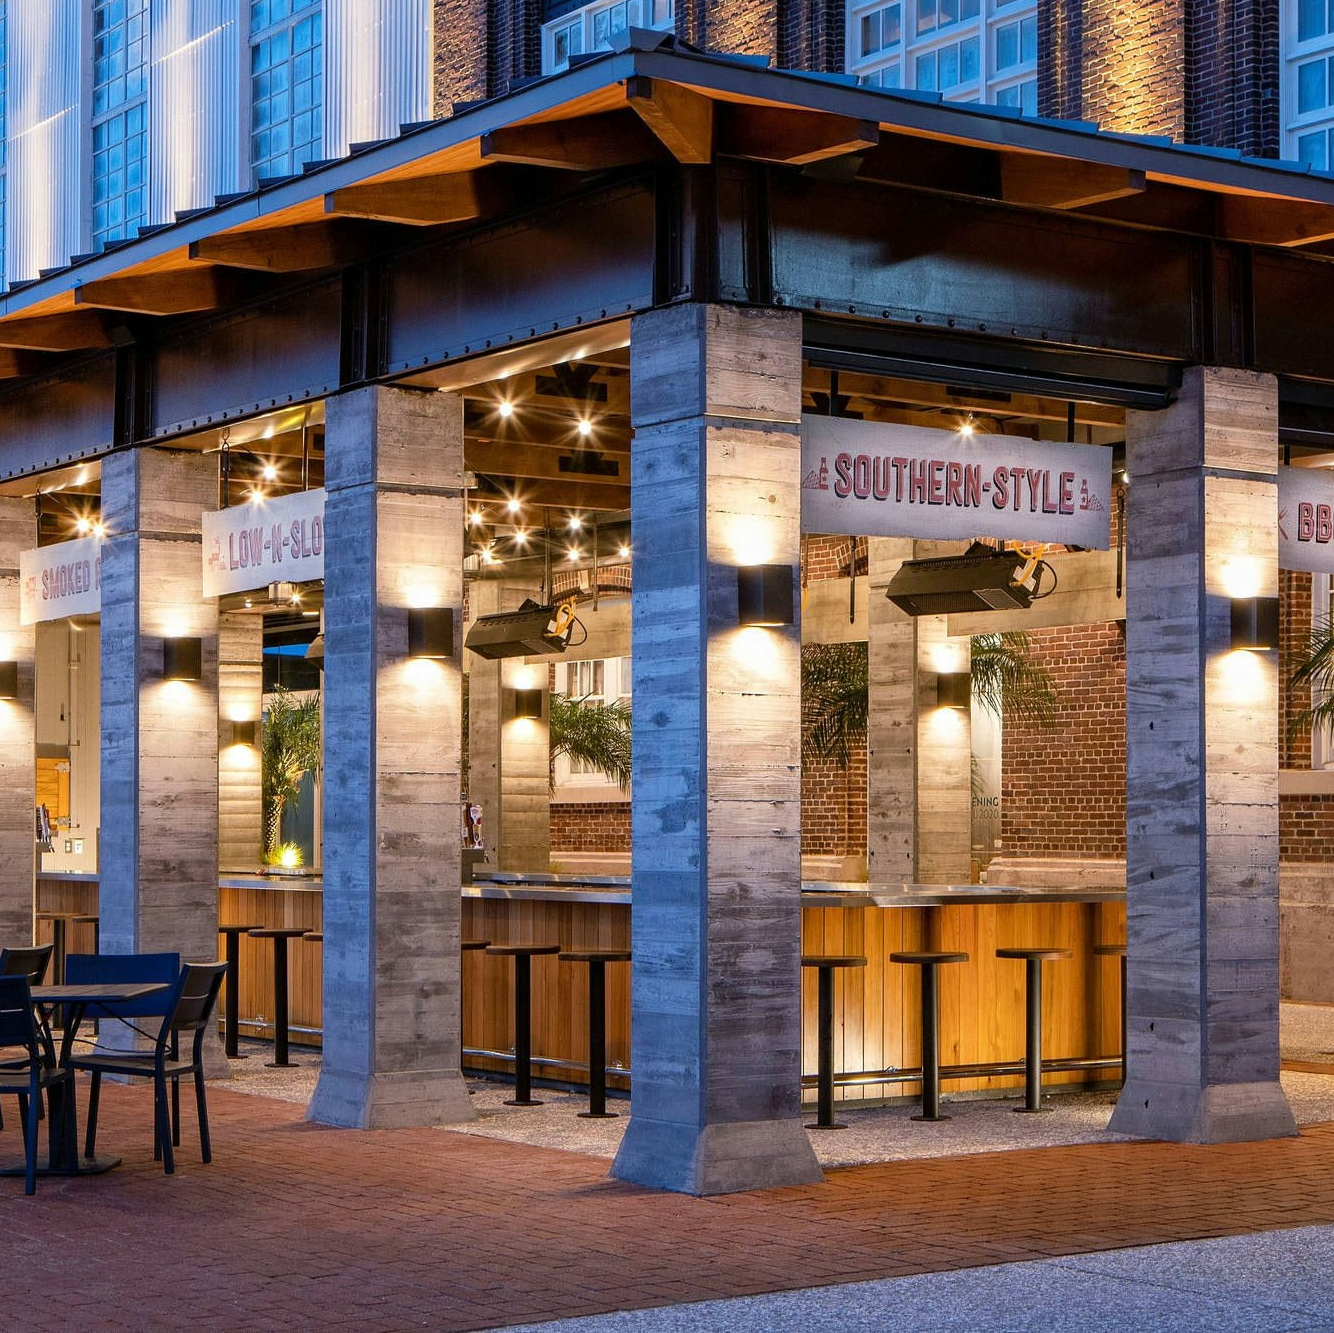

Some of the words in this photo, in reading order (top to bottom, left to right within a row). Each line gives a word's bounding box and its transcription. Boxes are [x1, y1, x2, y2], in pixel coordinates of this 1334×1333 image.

[834, 452, 1076, 515] SOUTHERN-STYLE
[229, 515, 325, 571] LOW-N-SLO
[42, 560, 91, 600] SMOKED
[971, 797, 999, 806] ENING
